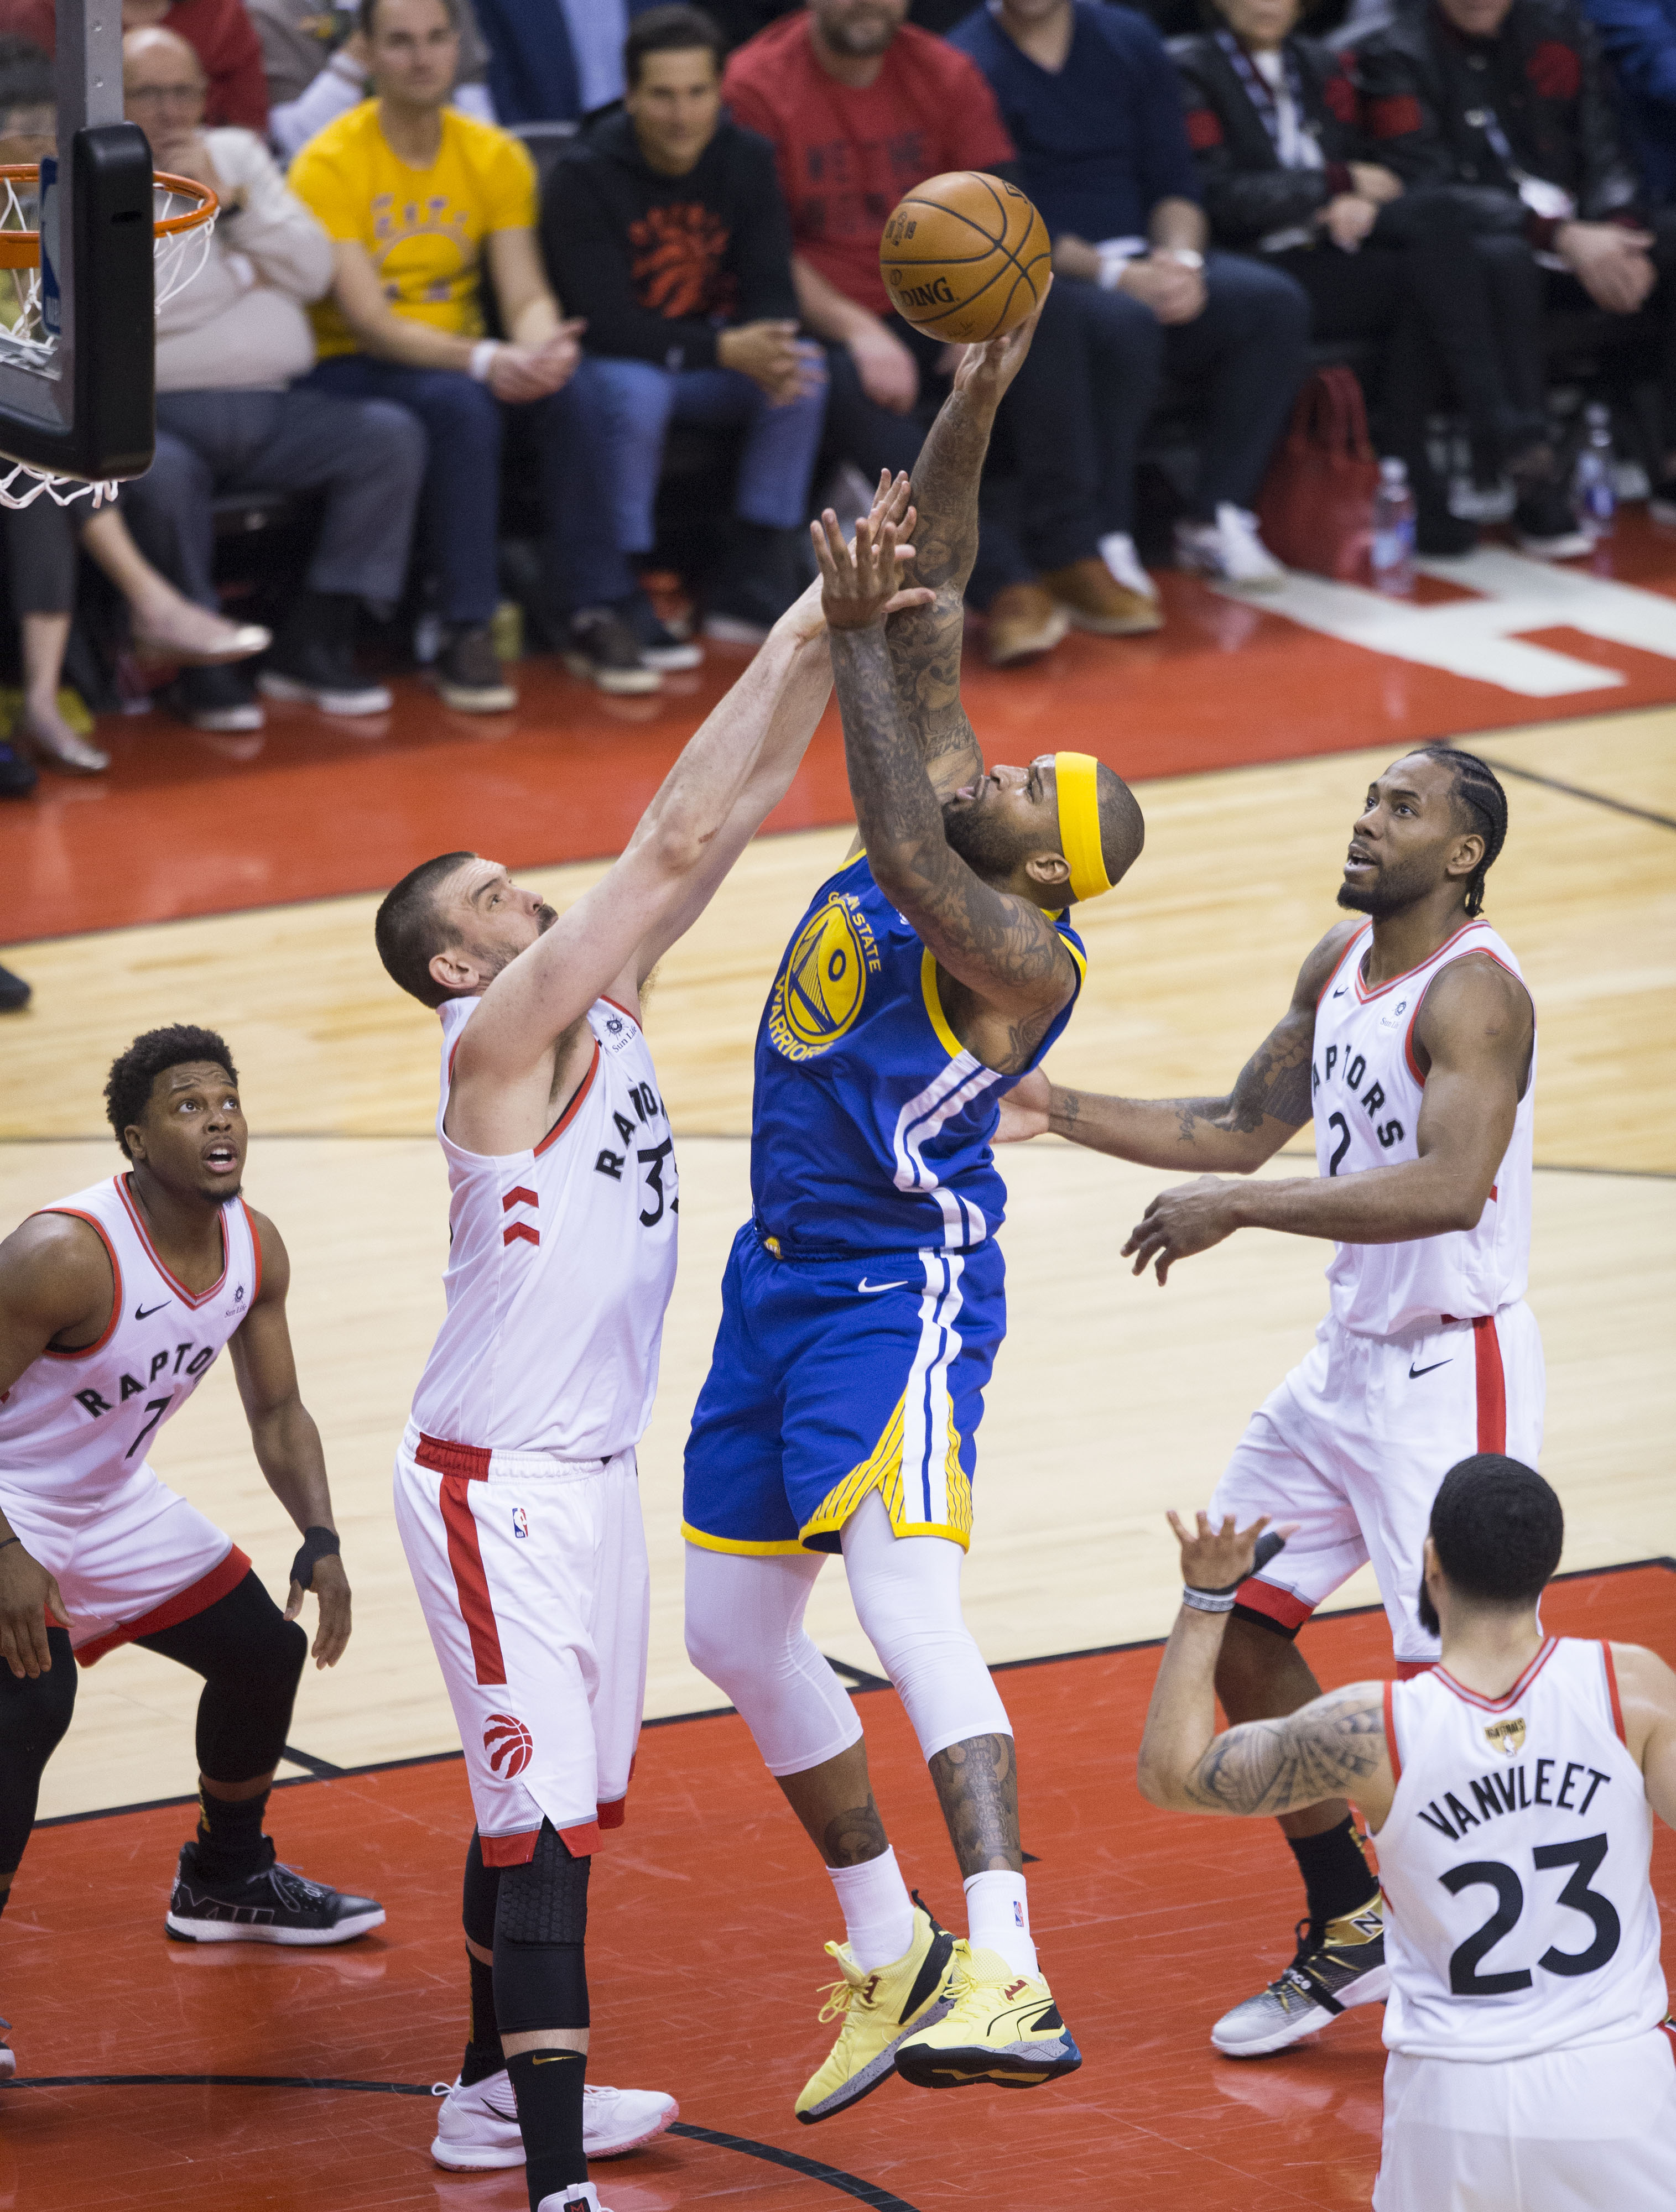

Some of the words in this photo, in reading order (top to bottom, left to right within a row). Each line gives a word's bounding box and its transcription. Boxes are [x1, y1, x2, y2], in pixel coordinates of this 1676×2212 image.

[898, 276, 955, 306] DING
[828, 948, 846, 983] 0
[852, 912, 881, 974] STATE
[612, 1039, 628, 1053] Sun
[768, 973, 835, 1061] WARRIOR
[637, 1136, 679, 1227] 3
[225, 1309, 236, 1318] Sun
[72, 1342, 216, 1420] RAPTO
[124, 1393, 175, 1461] 7
[1417, 1758, 1611, 1842] VANVLEET
[1438, 1832, 1621, 1996] 23
